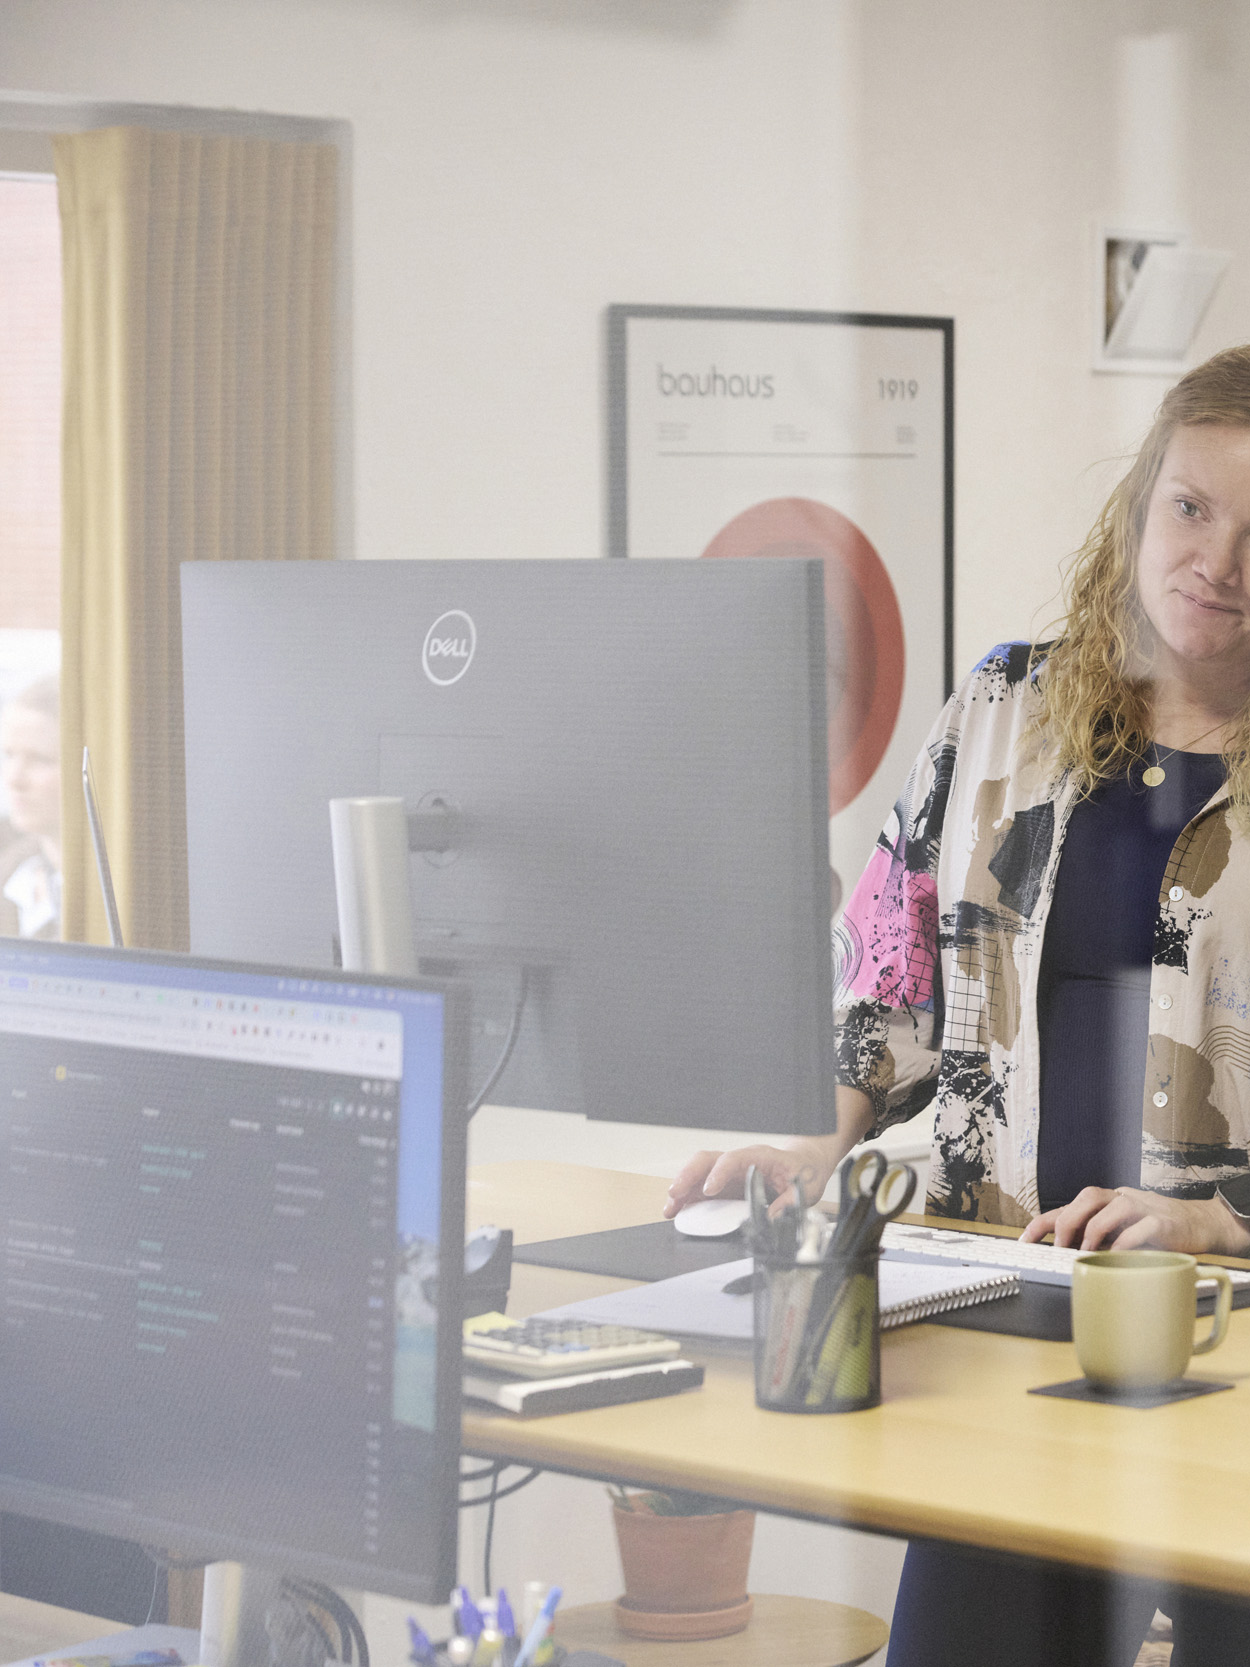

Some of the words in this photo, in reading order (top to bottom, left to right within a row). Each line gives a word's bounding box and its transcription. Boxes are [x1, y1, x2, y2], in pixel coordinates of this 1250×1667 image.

[656, 363, 776, 399] bauhaus
[878, 378, 919, 400] 1919
[428, 637, 469, 657] DELL
